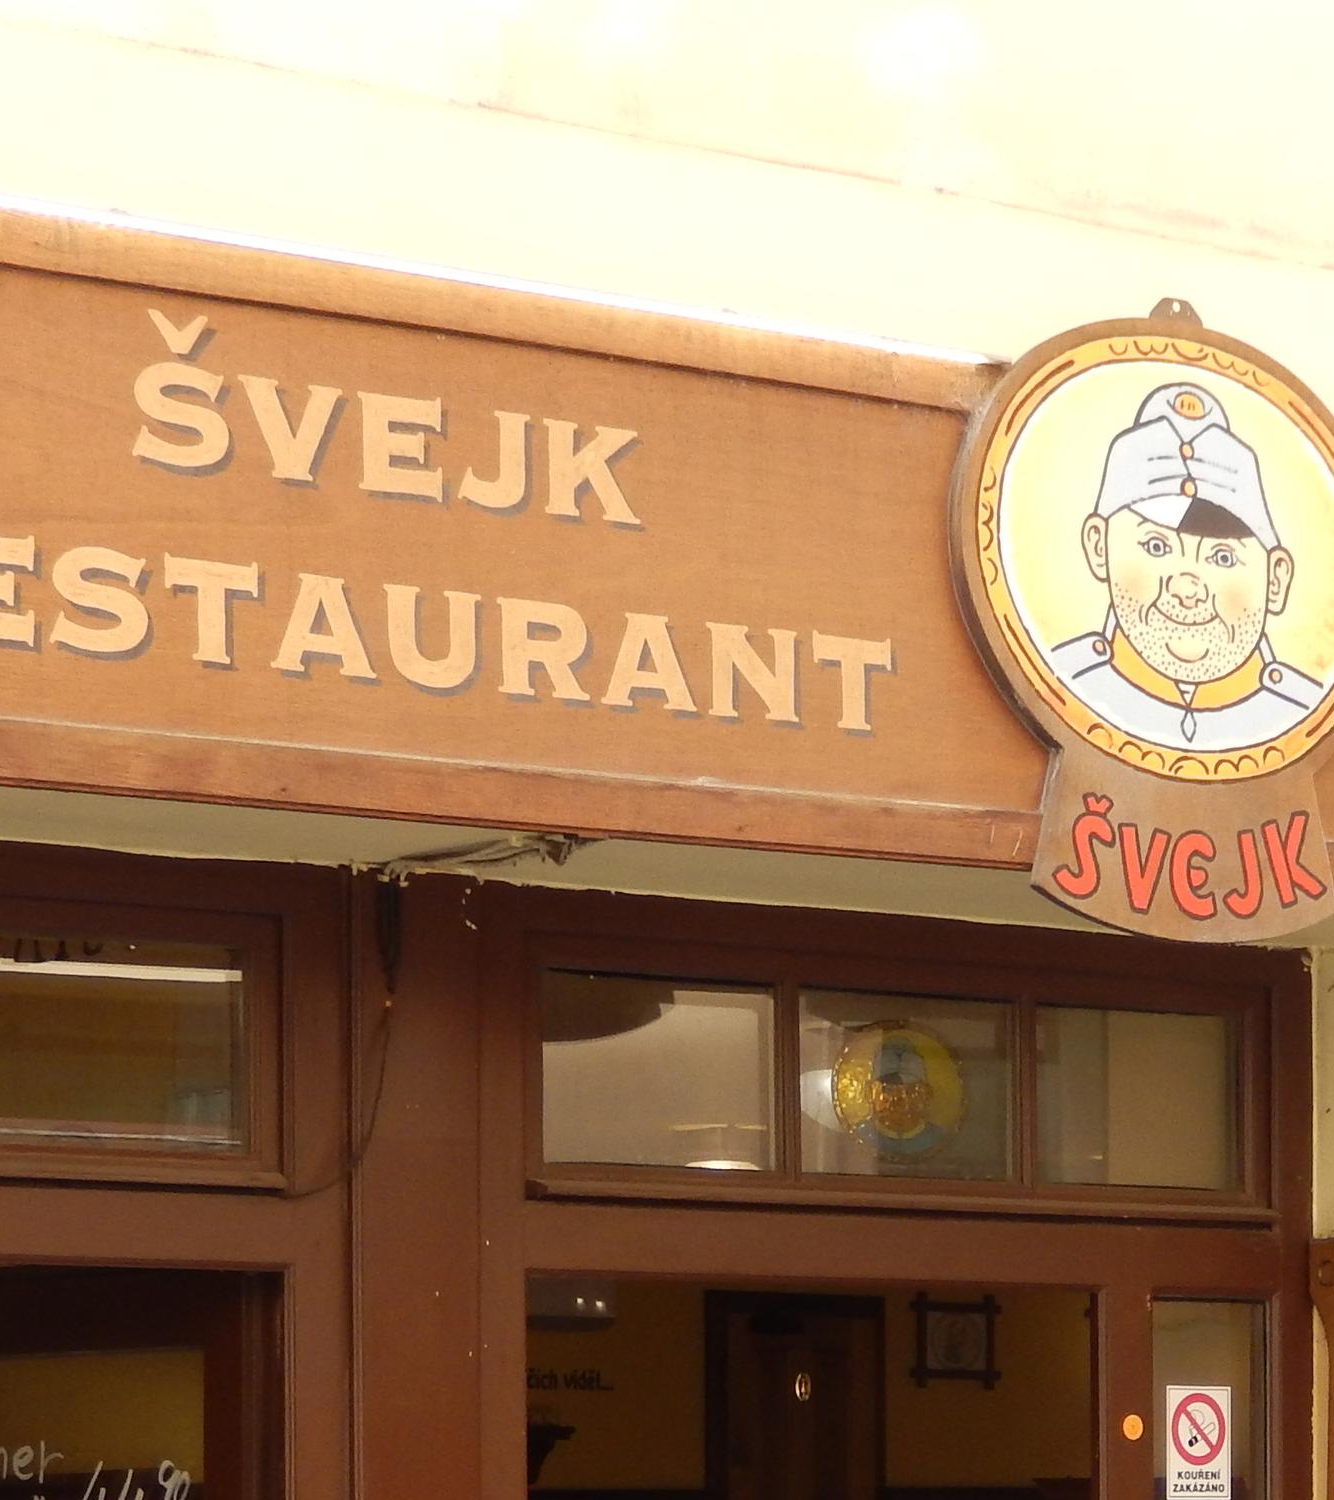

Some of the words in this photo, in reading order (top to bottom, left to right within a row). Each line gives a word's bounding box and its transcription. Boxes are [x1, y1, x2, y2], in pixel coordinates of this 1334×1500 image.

[130, 308, 643, 529] ŠVEJK
[1052, 791, 1328, 919] ŠVEJK
[1172, 1482, 1225, 1493] ZAKÁZÁNO
[1177, 1468, 1221, 1481] KOUŘENÍ
